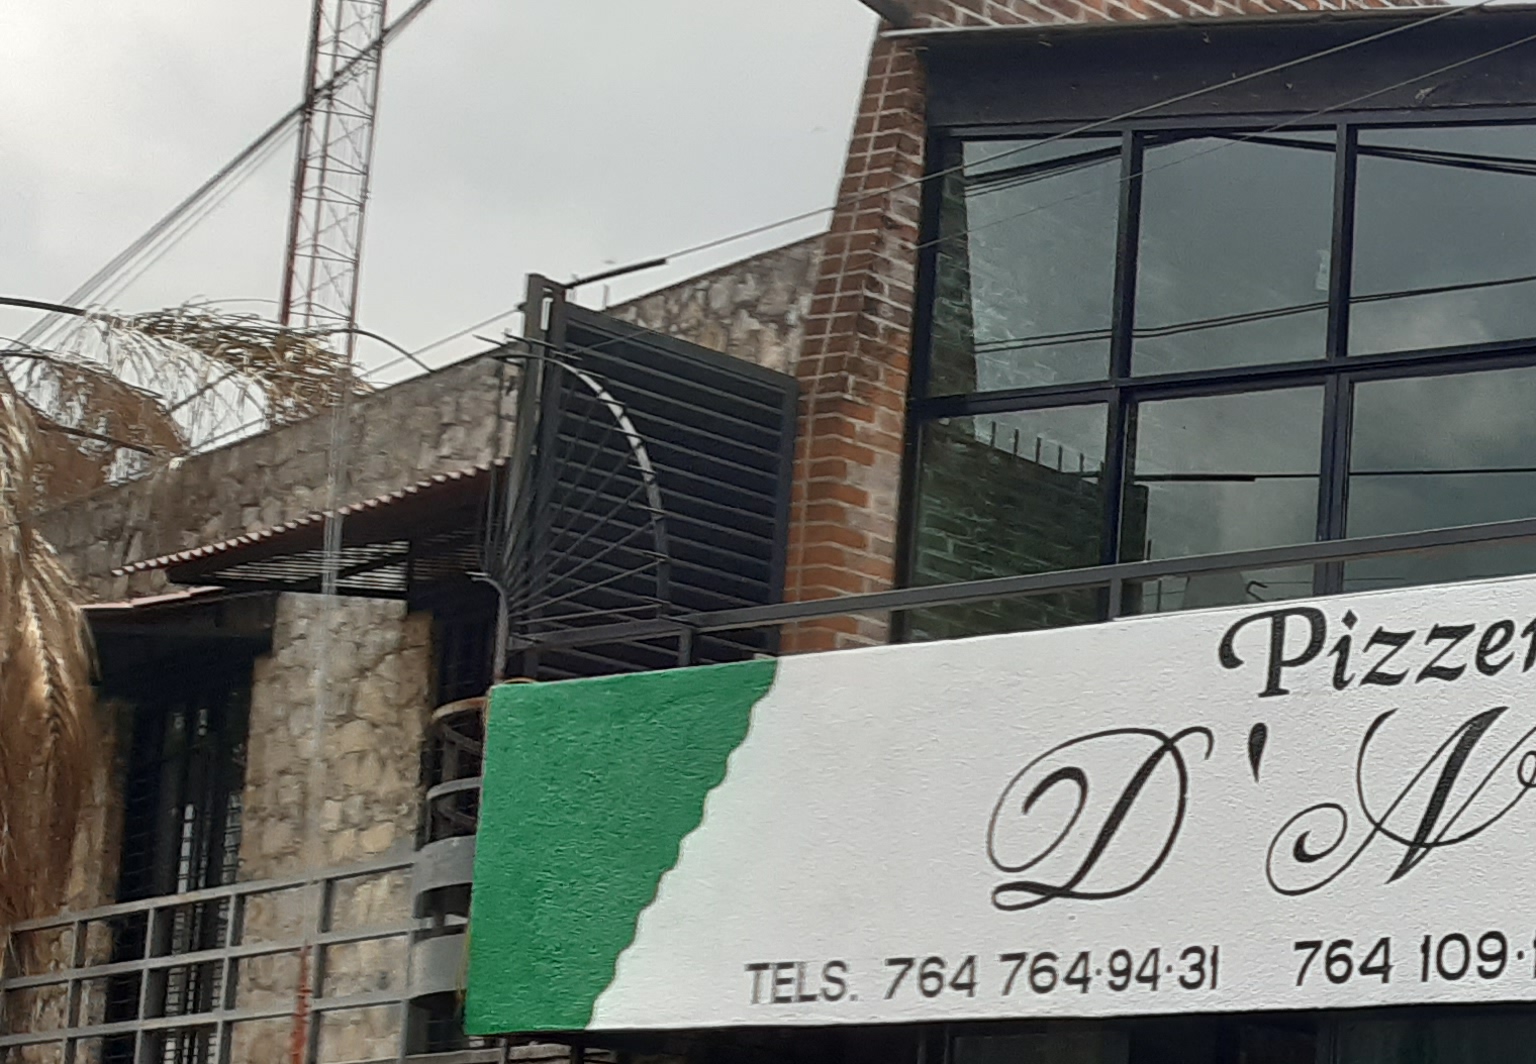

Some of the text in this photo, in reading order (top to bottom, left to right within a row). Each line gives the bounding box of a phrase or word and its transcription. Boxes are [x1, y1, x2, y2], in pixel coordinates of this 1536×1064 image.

[745, 960, 858, 1003] TELS.
[883, 955, 978, 1000] 764
[1293, 936, 1393, 987] 764
